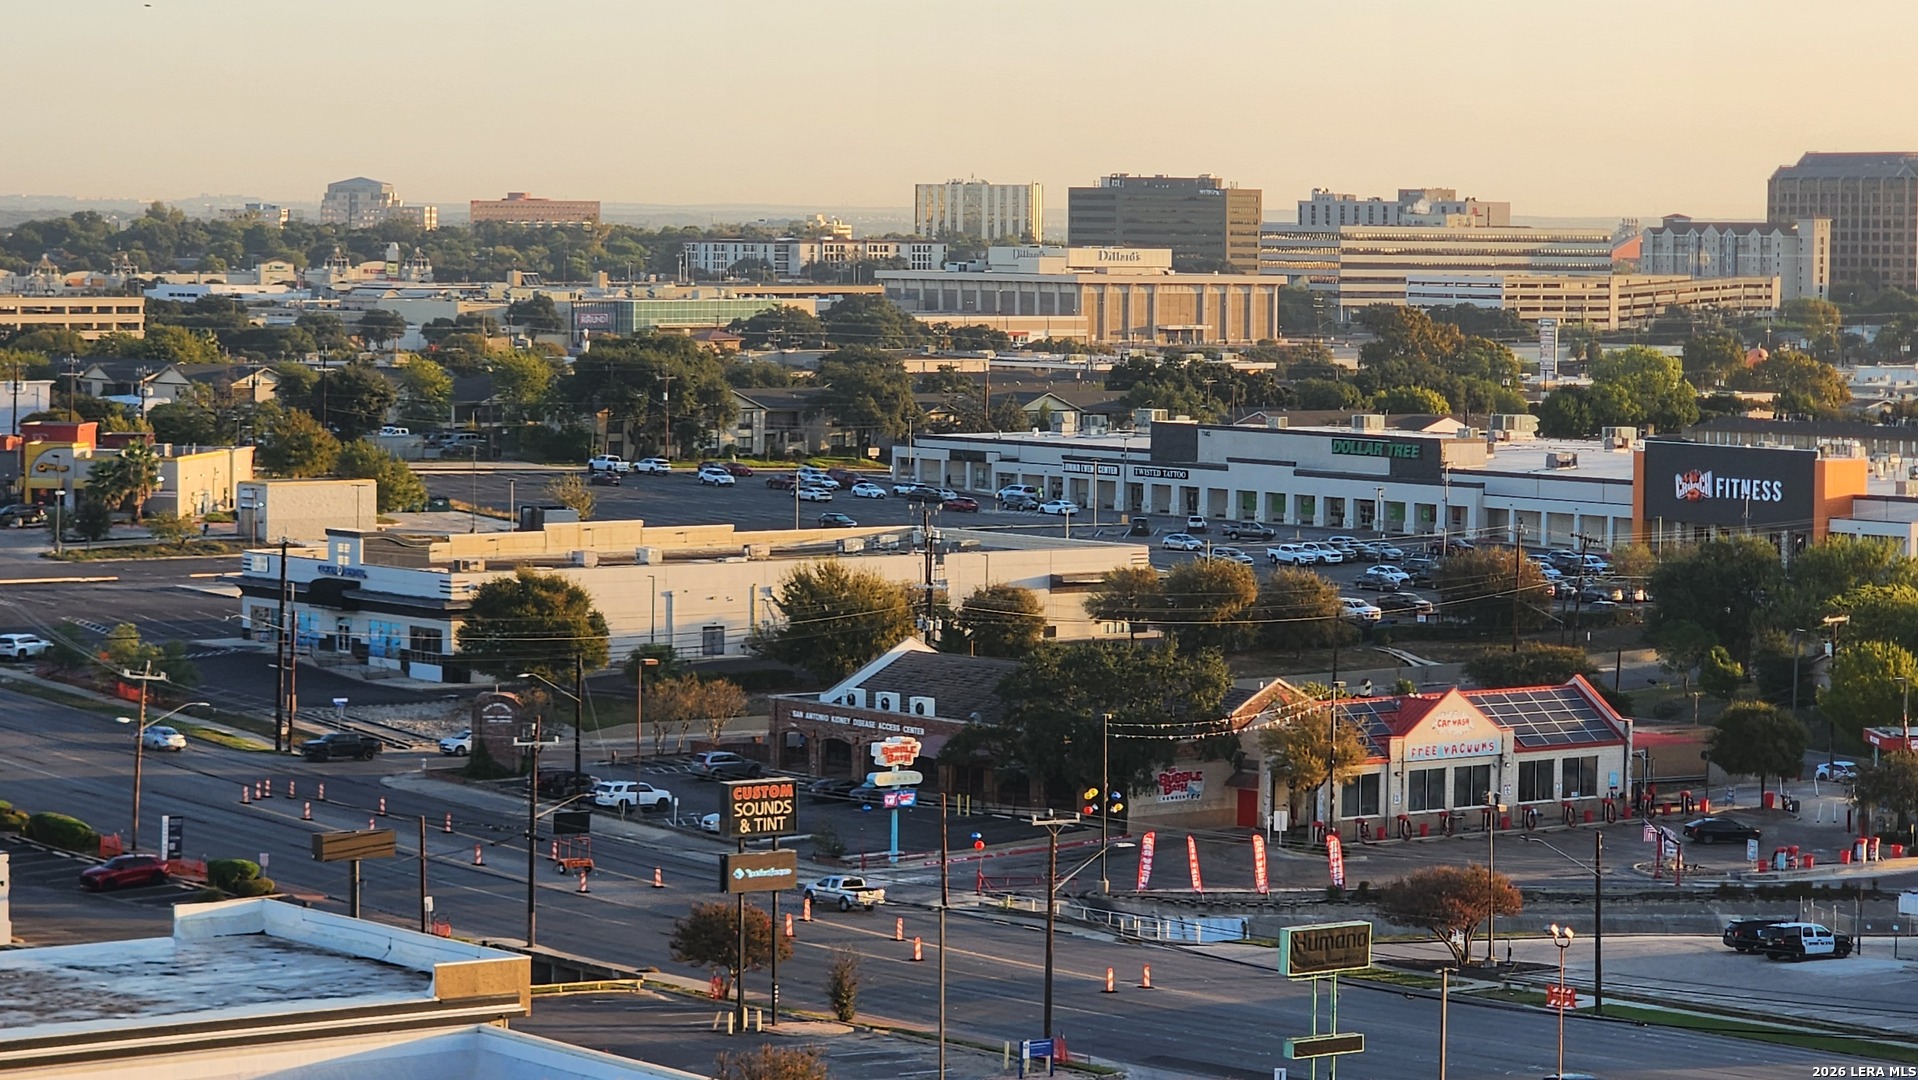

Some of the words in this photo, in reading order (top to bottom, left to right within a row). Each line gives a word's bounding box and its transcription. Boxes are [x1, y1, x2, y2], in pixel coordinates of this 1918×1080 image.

[1098, 250, 1141, 261] Dillard's
[1332, 440, 1383, 456] DOLLAR
[1387, 444, 1420, 458] TREE
[1134, 467, 1161, 477] TWISTED
[1162, 469, 1187, 479] TATTOO
[1675, 470, 1713, 500] CRUNCH
[1716, 477, 1782, 502] FITNESS
[792, 710, 803, 718] SAN
[805, 712, 829, 722] ANTONIO
[831, 715, 851, 725] KIDNEY
[853, 718, 876, 729] DISEASE
[878, 722, 901, 732] ACCESS
[903, 725, 925, 735] CENTER
[881, 745, 918, 757] BUBBLE
[1444, 741, 1495, 755] VACUUMS
[886, 754, 912, 764] BATH
[1158, 771, 1203, 787] BUBBLE
[733, 784, 794, 801] CUSTOM
[1164, 782, 1189, 796] BATH
[734, 800, 793, 818] SOUNDS
[740, 818, 752, 834] &
[754, 816, 787, 833] TINT
